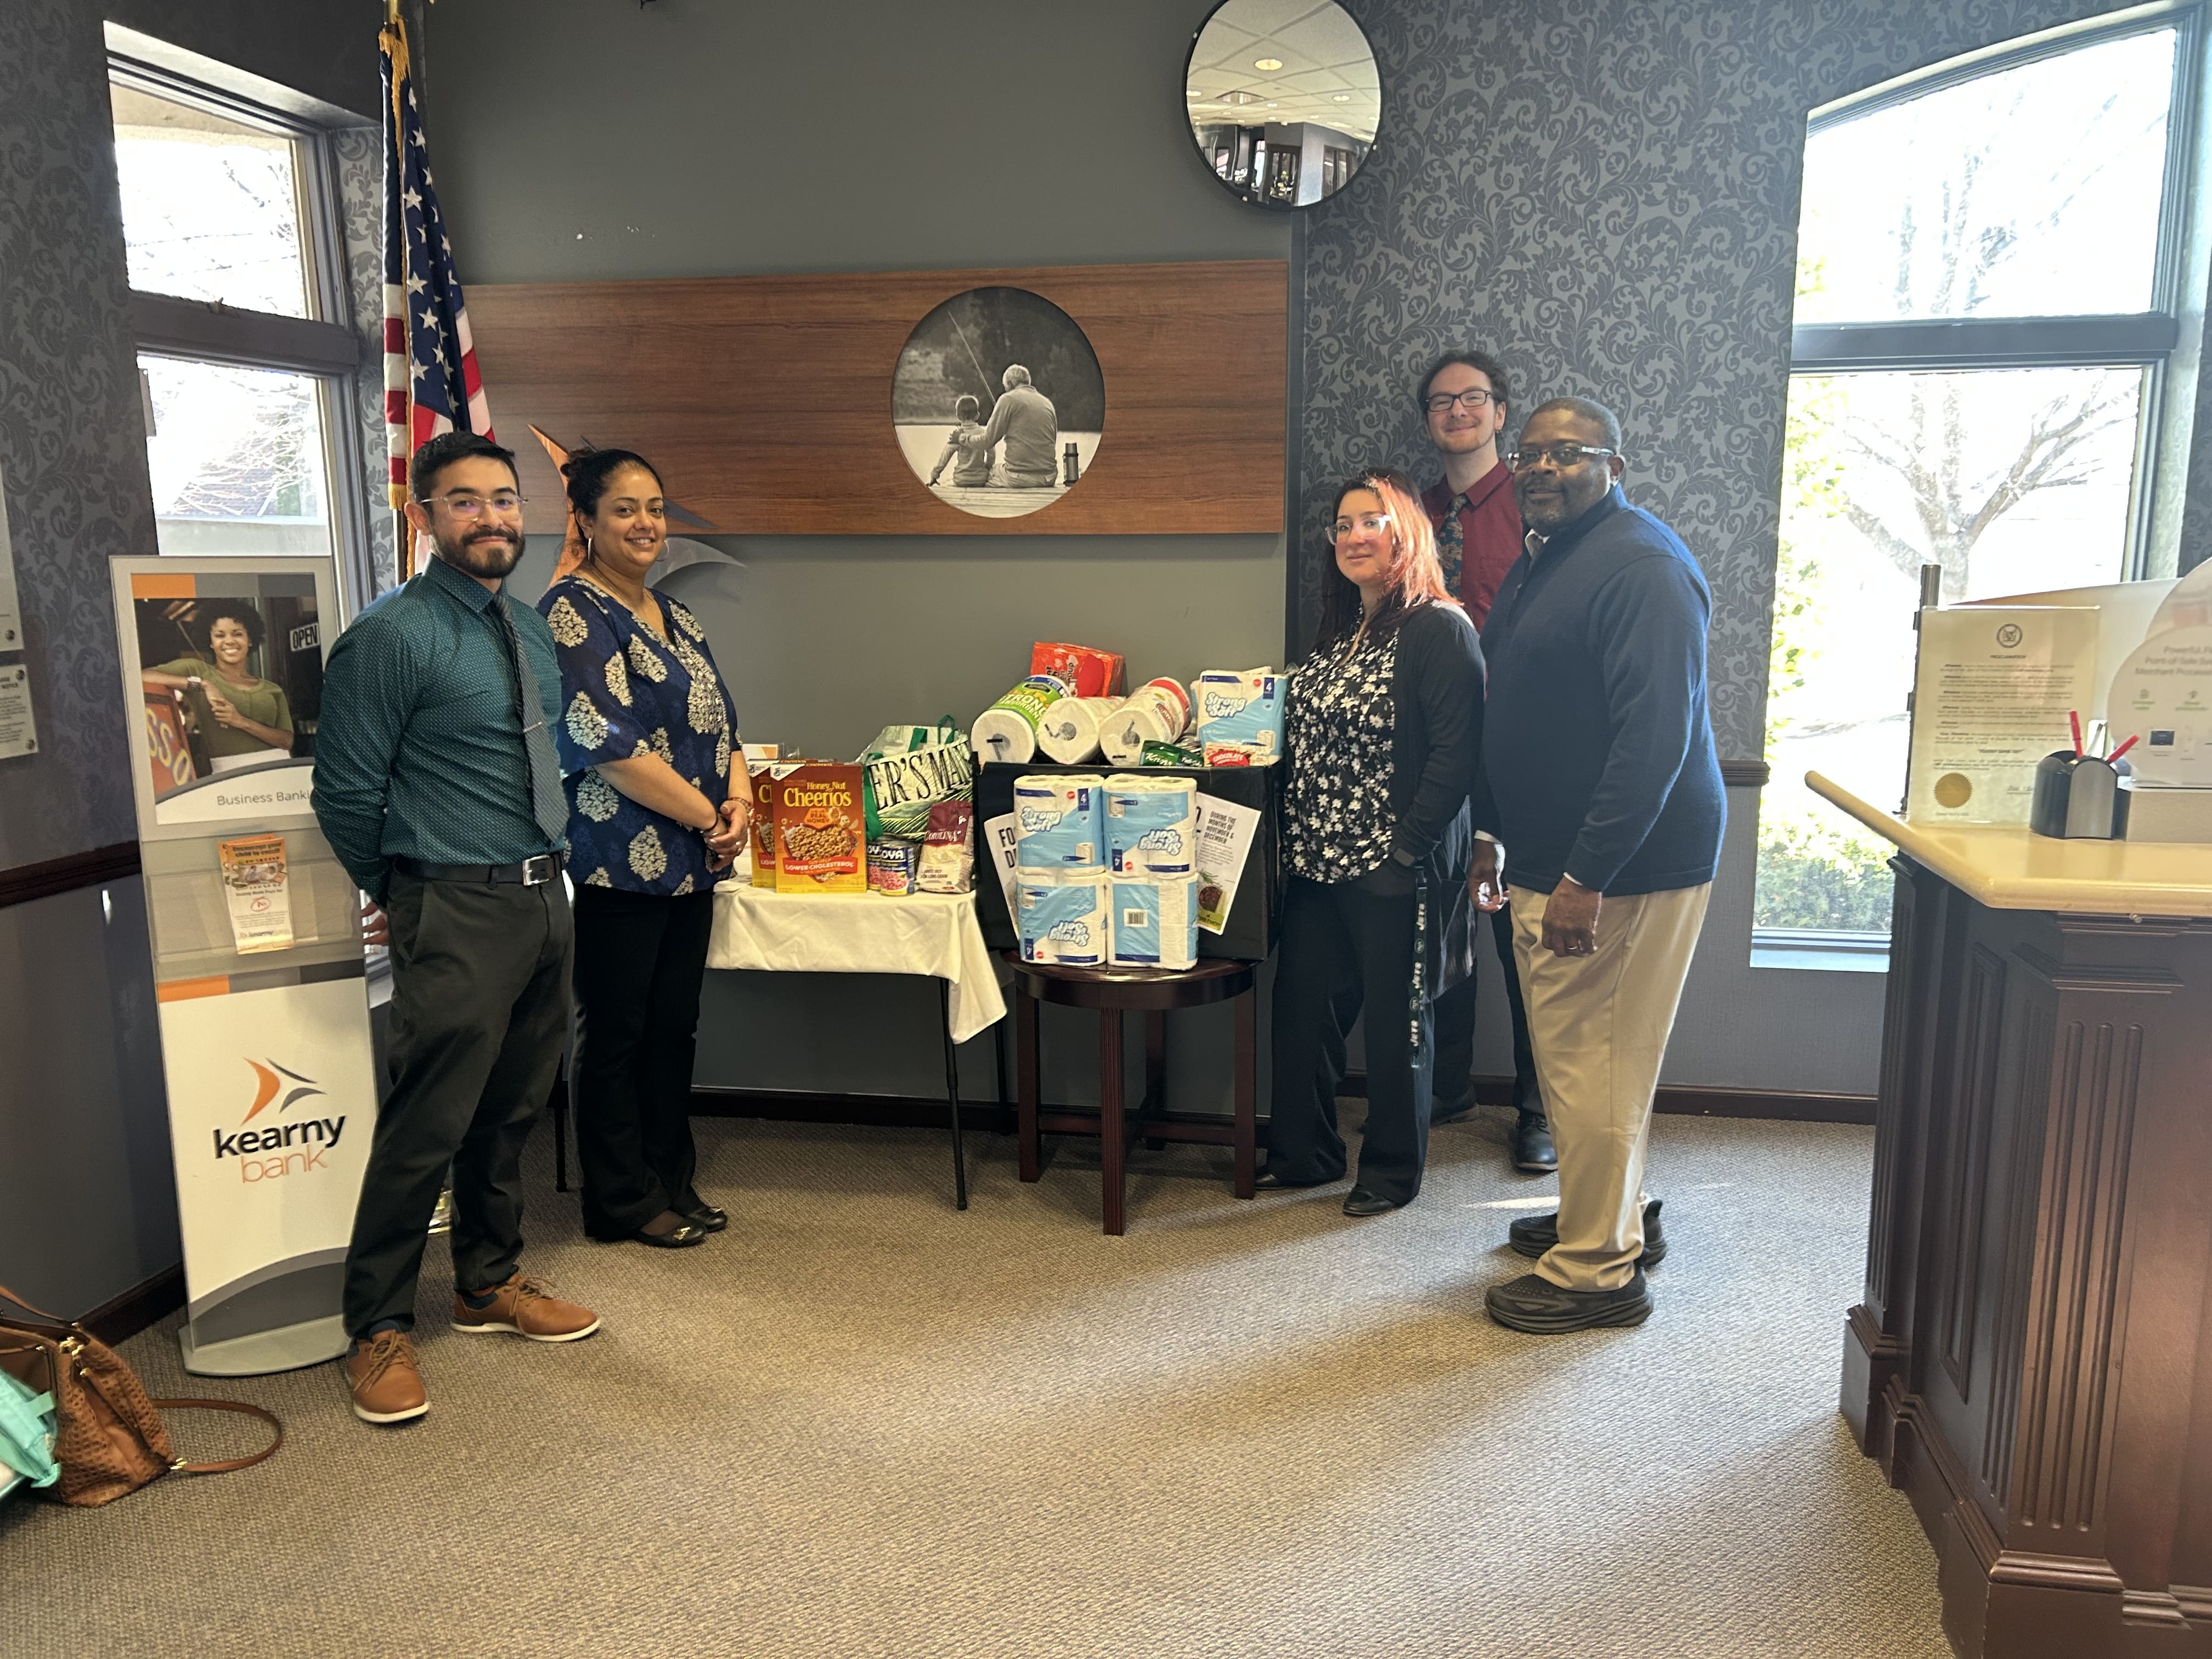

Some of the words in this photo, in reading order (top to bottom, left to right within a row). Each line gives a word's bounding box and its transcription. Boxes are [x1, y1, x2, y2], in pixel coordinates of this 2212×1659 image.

[292, 626, 318, 649] OPEN
[1266, 682, 1272, 692] 4
[1206, 692, 1247, 712] Strong
[1146, 752, 1173, 766] Knorr
[806, 781, 830, 791] Honey
[832, 781, 847, 791] Nut
[866, 755, 931, 810] ER'S
[217, 793, 273, 806] Business
[276, 789, 311, 803] Banki
[783, 788, 852, 808] Cheerios
[997, 827, 1015, 848] FO
[1137, 835, 1182, 856] Strong
[867, 845, 880, 855] OY
[882, 850, 904, 860] OYA
[809, 861, 855, 870] CHOLESTEROL
[212, 1115, 347, 1160] kearny
[240, 1144, 329, 1184] bank
